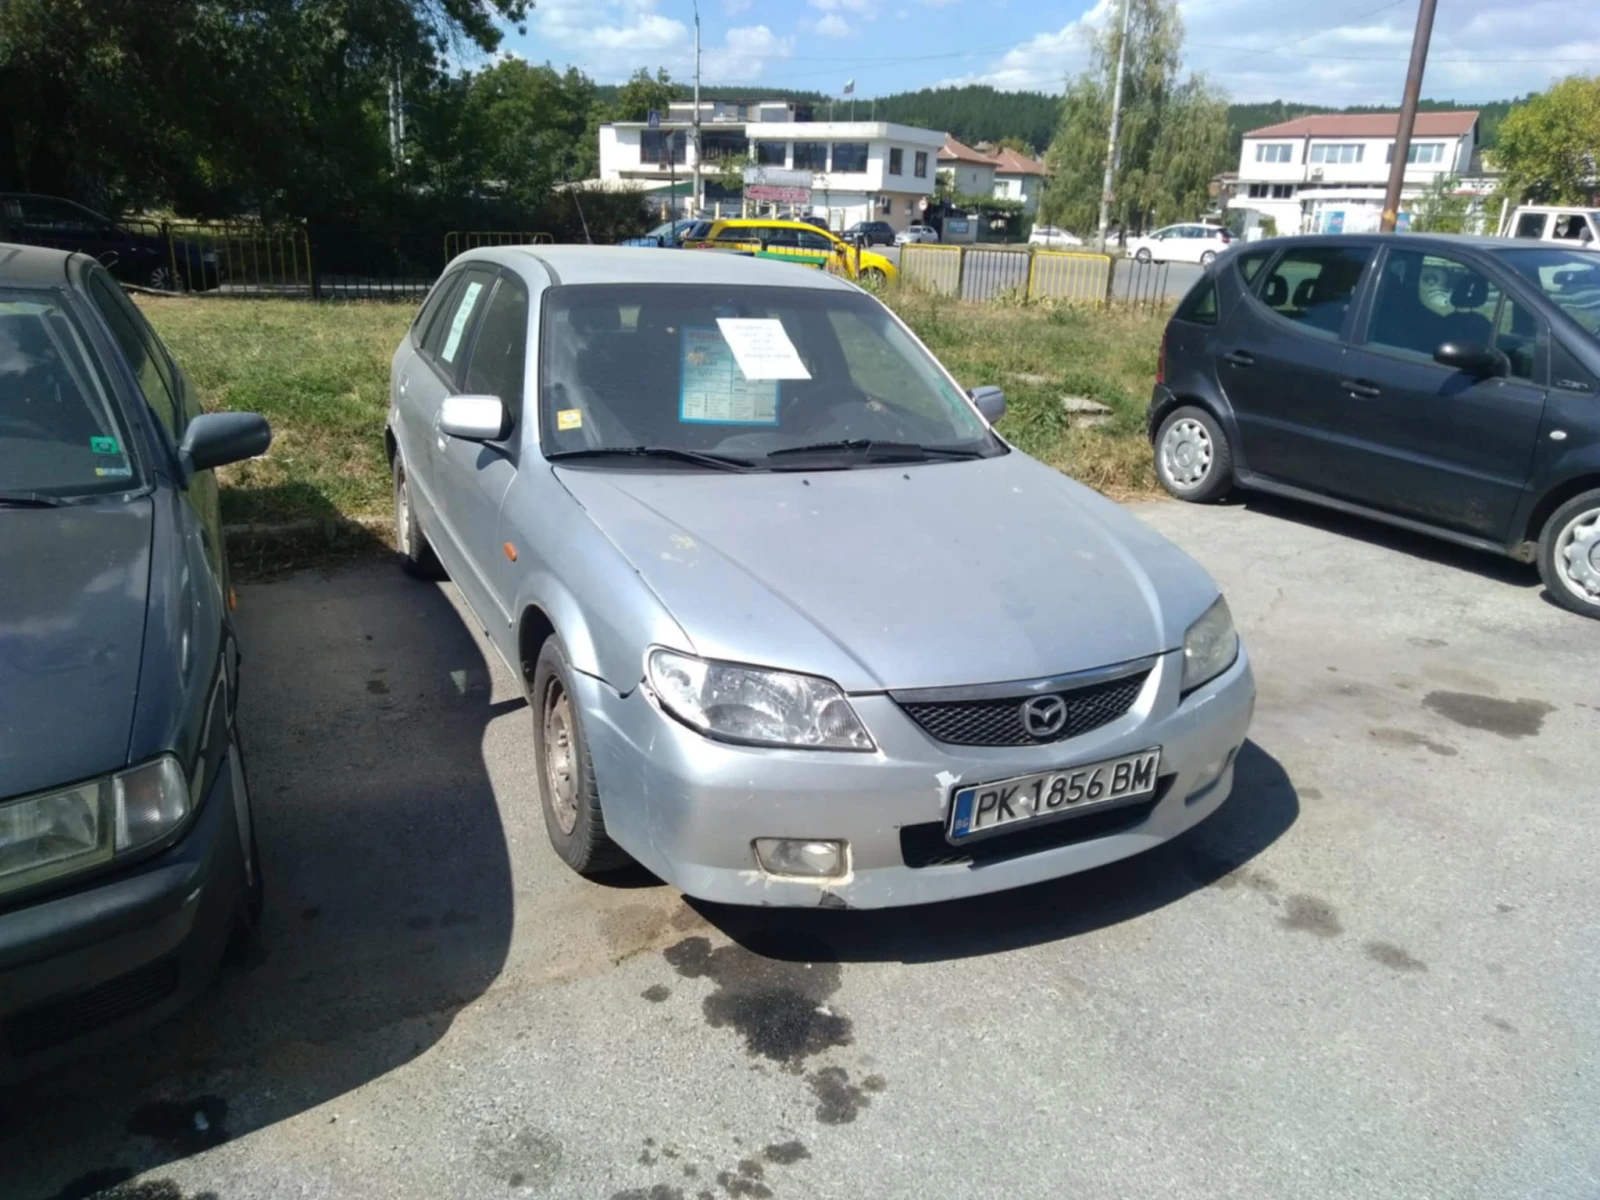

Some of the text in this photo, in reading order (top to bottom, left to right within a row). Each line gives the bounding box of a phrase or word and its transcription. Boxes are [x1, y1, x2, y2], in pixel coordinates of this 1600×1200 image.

[974, 756, 1155, 827] PK 1856 BM
[955, 818, 969, 828] BG
